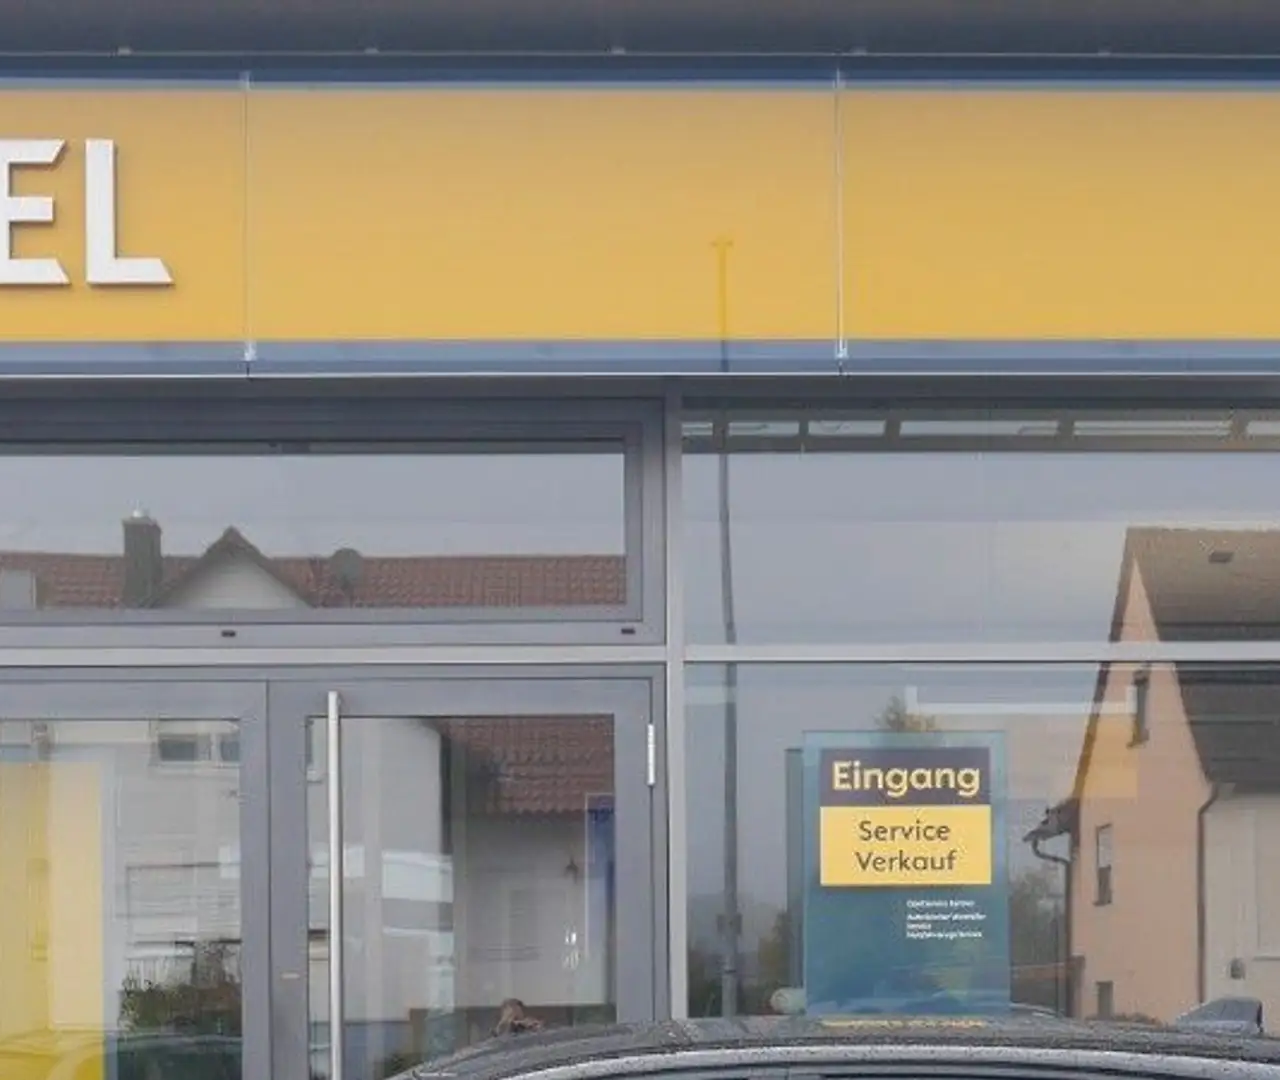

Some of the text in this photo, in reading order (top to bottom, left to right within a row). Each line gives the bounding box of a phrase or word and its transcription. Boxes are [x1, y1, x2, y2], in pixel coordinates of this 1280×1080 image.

[831, 760, 981, 798] Eingang
[858, 820, 951, 841] Service
[855, 850, 958, 872] Verkauf
